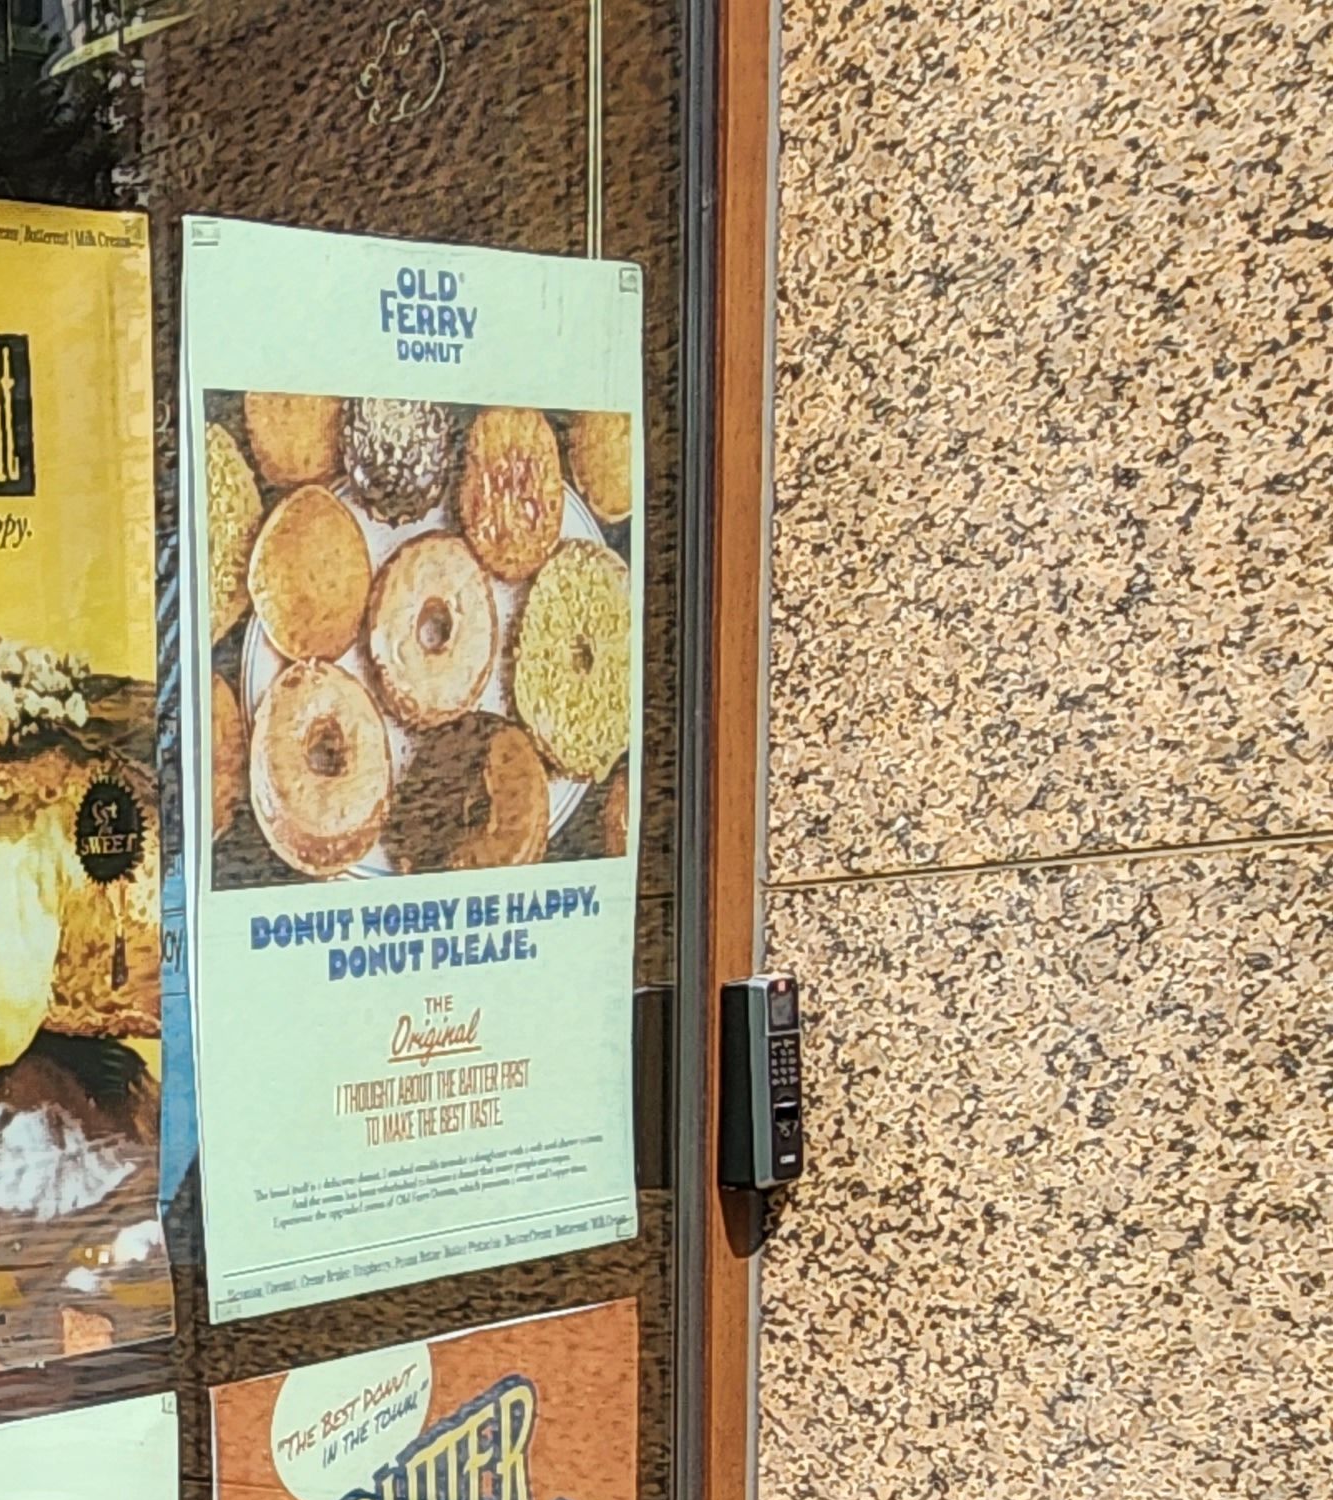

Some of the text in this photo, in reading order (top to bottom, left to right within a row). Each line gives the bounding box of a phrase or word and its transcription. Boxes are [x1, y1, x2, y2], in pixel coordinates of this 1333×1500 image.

[396, 267, 458, 301] OLD
[380, 288, 478, 340] FERRY
[397, 341, 464, 365] DONUT
[250, 885, 600, 950] DONUT WORRY BE HAPPY.
[328, 929, 537, 981] DONUT PLEASE.
[424, 995, 453, 1015] THE
[391, 1008, 481, 1066] Original
[343, 1077, 395, 1115] THOUGHT
[397, 1072, 433, 1105] ABOUT
[436, 1069, 457, 1099] THE
[458, 1062, 499, 1098] BATTER
[501, 1058, 531, 1090] FIRST
[365, 1117, 379, 1147] TO
[383, 1111, 415, 1144] MAKE
[417, 1107, 437, 1138] THE
[440, 1103, 466, 1134] BEST
[320, 1395, 361, 1440] BEST
[362, 1362, 418, 1412] DONUT
[322, 1440, 338, 1469] IN
[342, 1419, 370, 1455] THE
